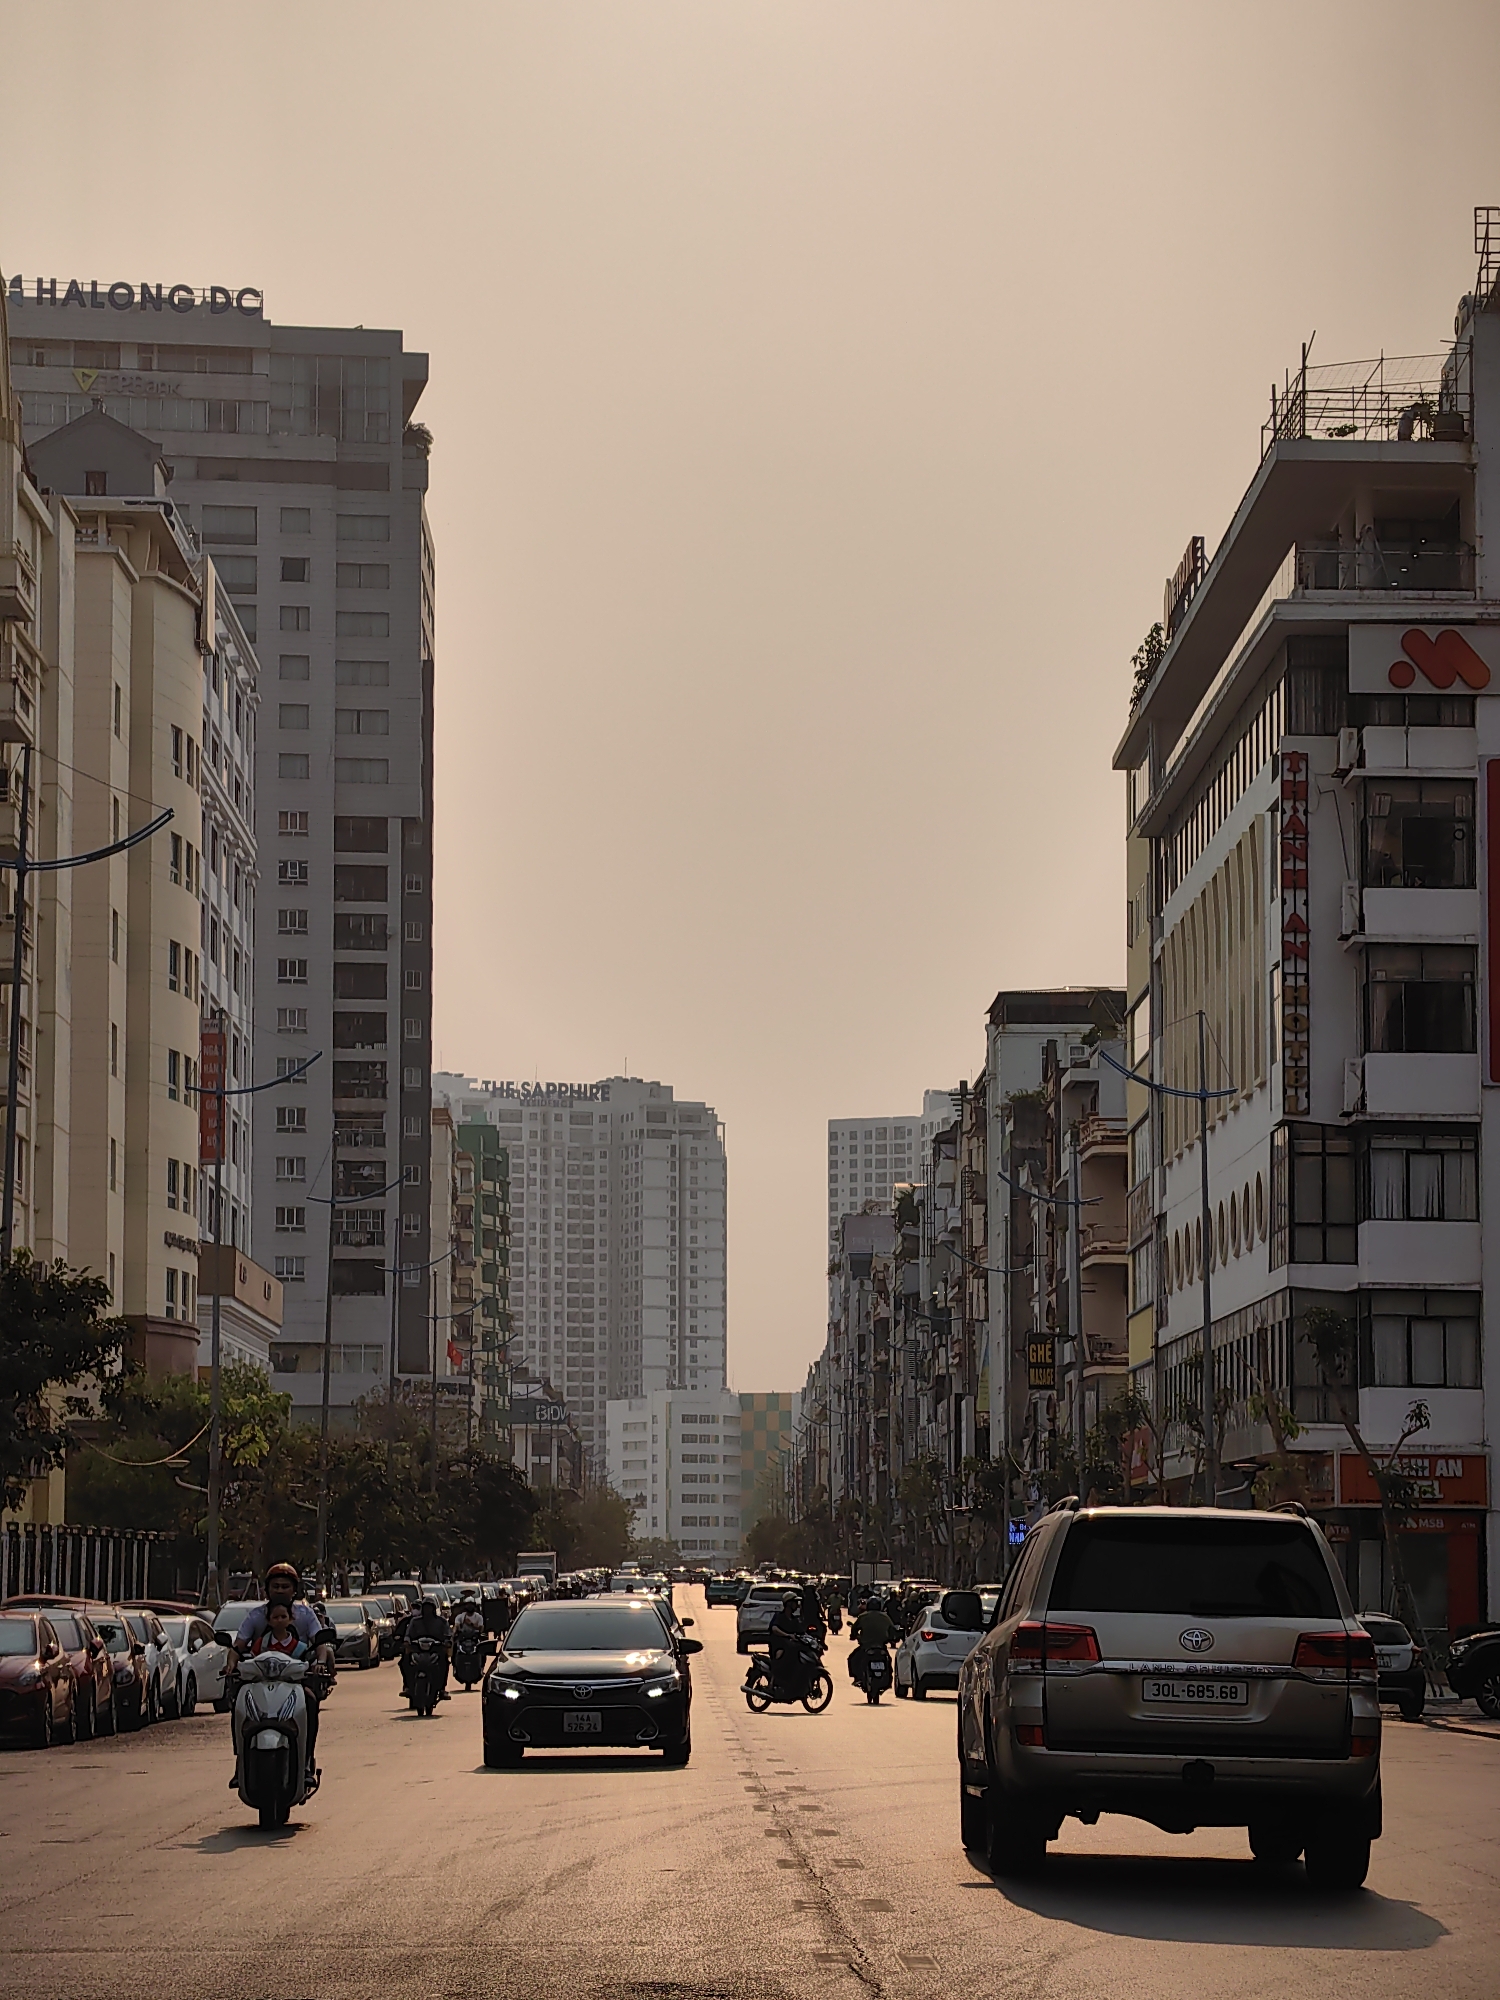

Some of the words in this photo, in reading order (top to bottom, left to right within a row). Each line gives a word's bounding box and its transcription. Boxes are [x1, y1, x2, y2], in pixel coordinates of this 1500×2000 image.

[36, 277, 195, 314] HALONG
[210, 285, 262, 316] DC
[1282, 985, 1309, 1116] HOTEL
[482, 1080, 515, 1098] THE
[521, 1081, 612, 1102] SAPPHIRE
[1029, 1338, 1053, 1363] GHẾ
[1435, 1458, 1463, 1477] AN
[1418, 1518, 1444, 1528] MSB
[1151, 1682, 1239, 1700] 30L-685.68
